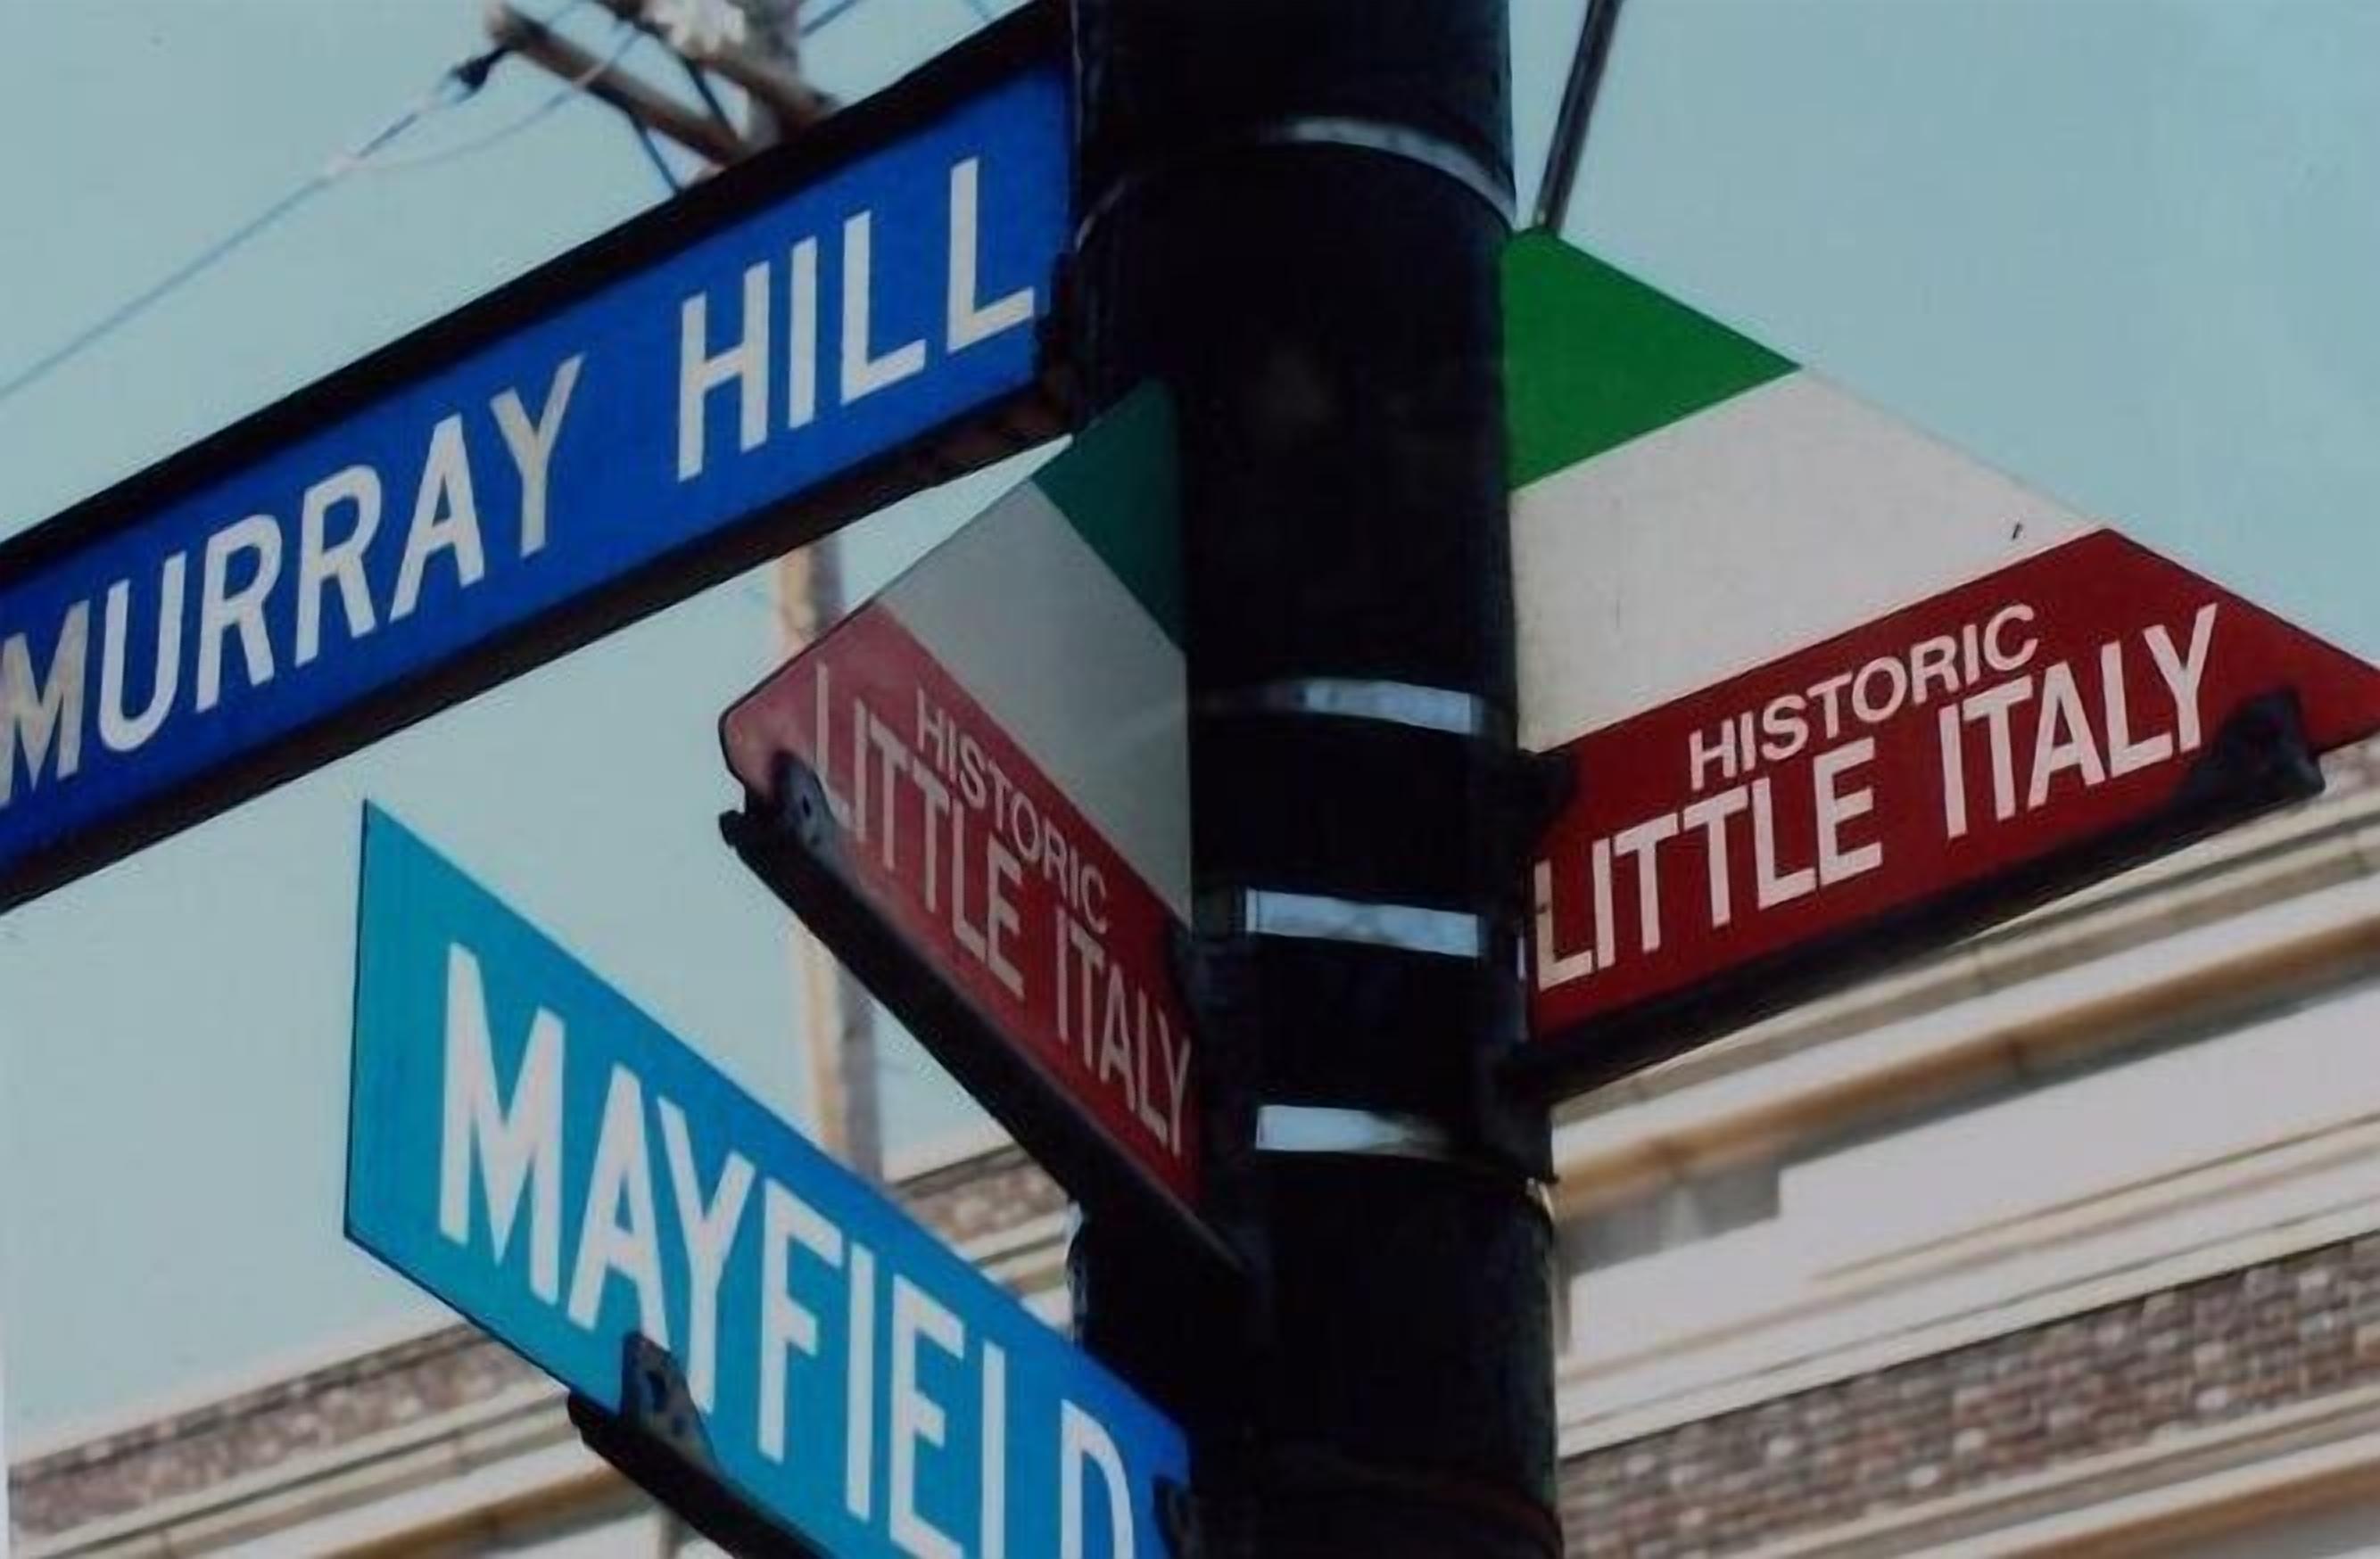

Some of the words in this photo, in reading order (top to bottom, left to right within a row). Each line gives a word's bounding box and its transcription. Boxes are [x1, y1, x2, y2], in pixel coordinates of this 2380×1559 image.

[0, 354, 583, 806] MURRAY
[678, 156, 1036, 483] HILL
[916, 685, 1108, 936] HISTORIC
[1534, 738, 1883, 992] LITTLE
[1938, 602, 2219, 839] ITALY
[1689, 603, 2039, 791] HISTORIC
[815, 662, 1025, 1002] LITTLE
[1055, 907, 1192, 1158] ITALY
